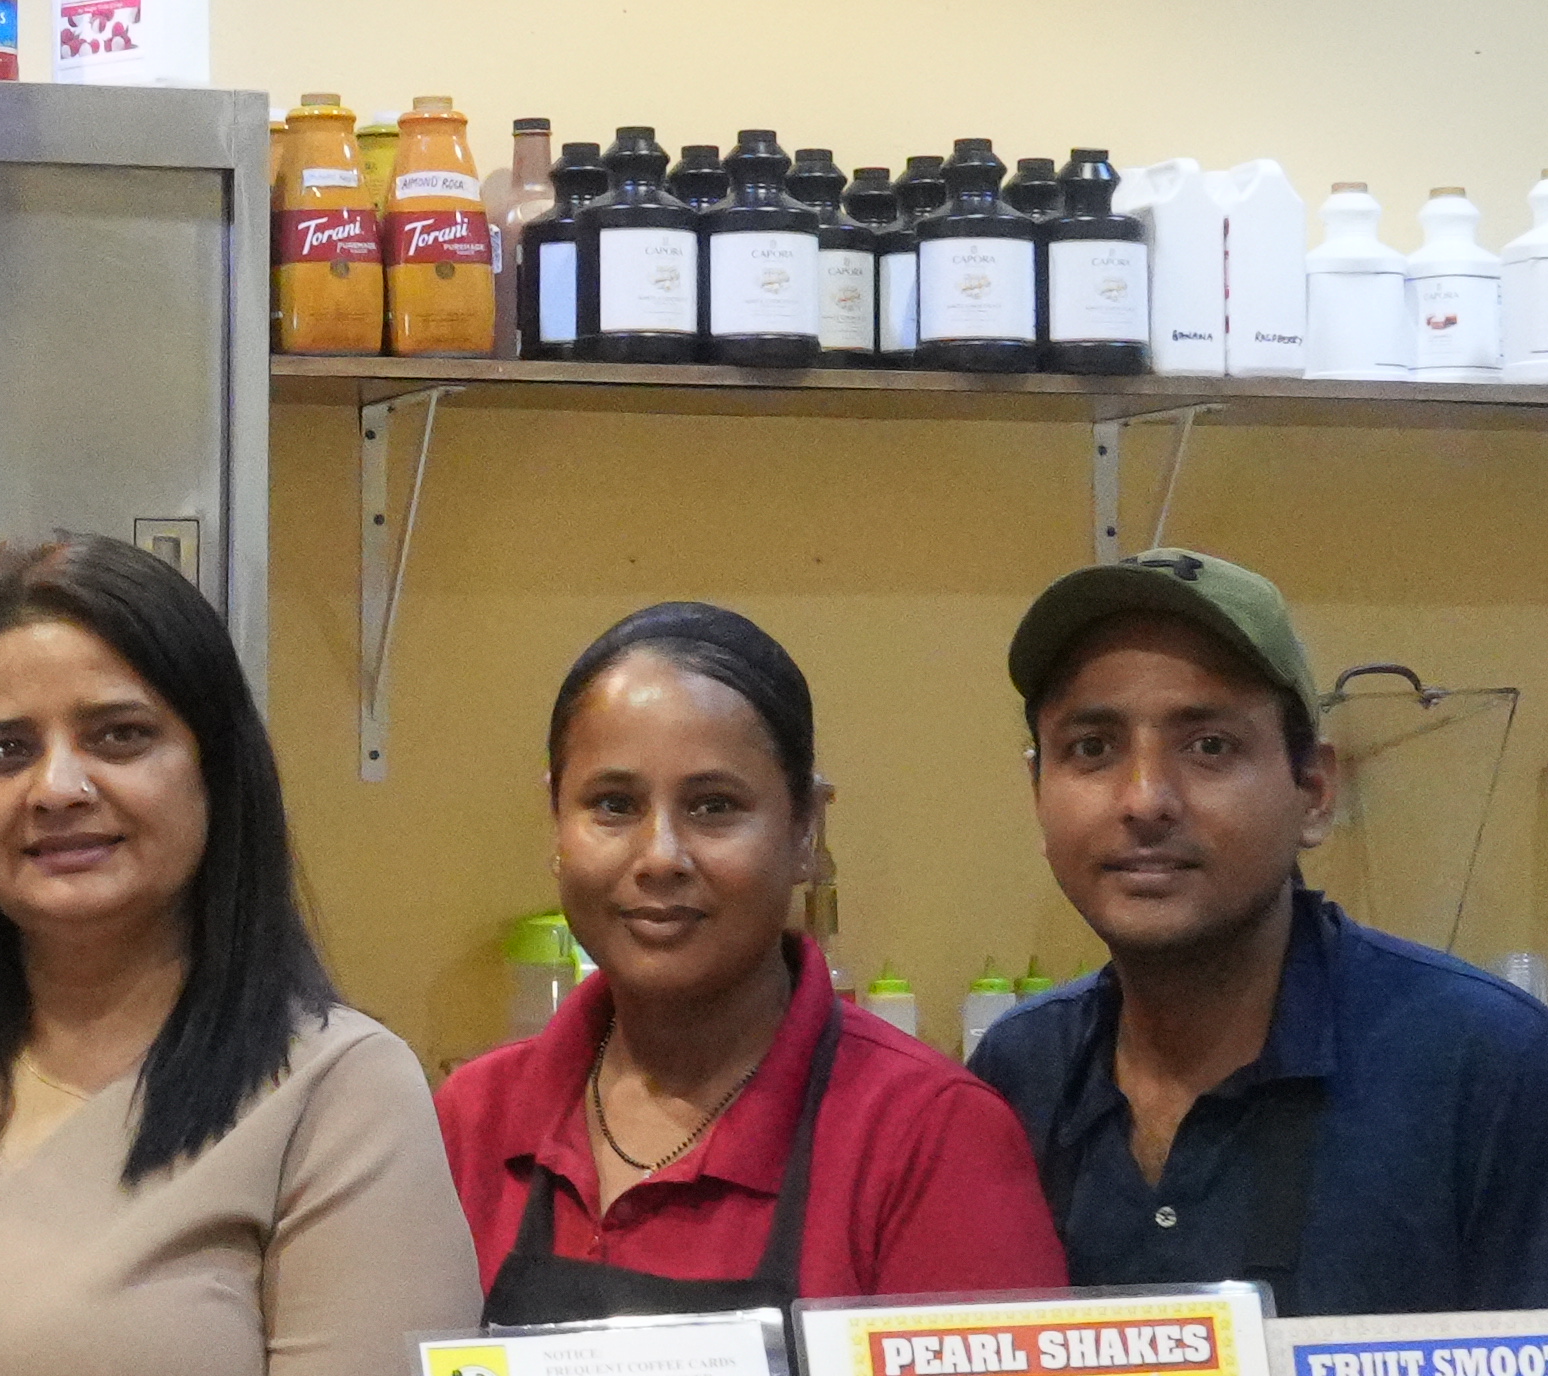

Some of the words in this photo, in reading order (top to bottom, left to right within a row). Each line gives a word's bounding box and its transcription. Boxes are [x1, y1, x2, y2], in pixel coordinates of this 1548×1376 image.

[298, 218, 362, 255] Torani
[404, 218, 469, 256] Torani
[751, 248, 794, 259] CAPORA
[952, 254, 996, 265] CAPORA
[884, 1331, 1029, 1376] PEARL
[1043, 1321, 1211, 1368] SHAKES
